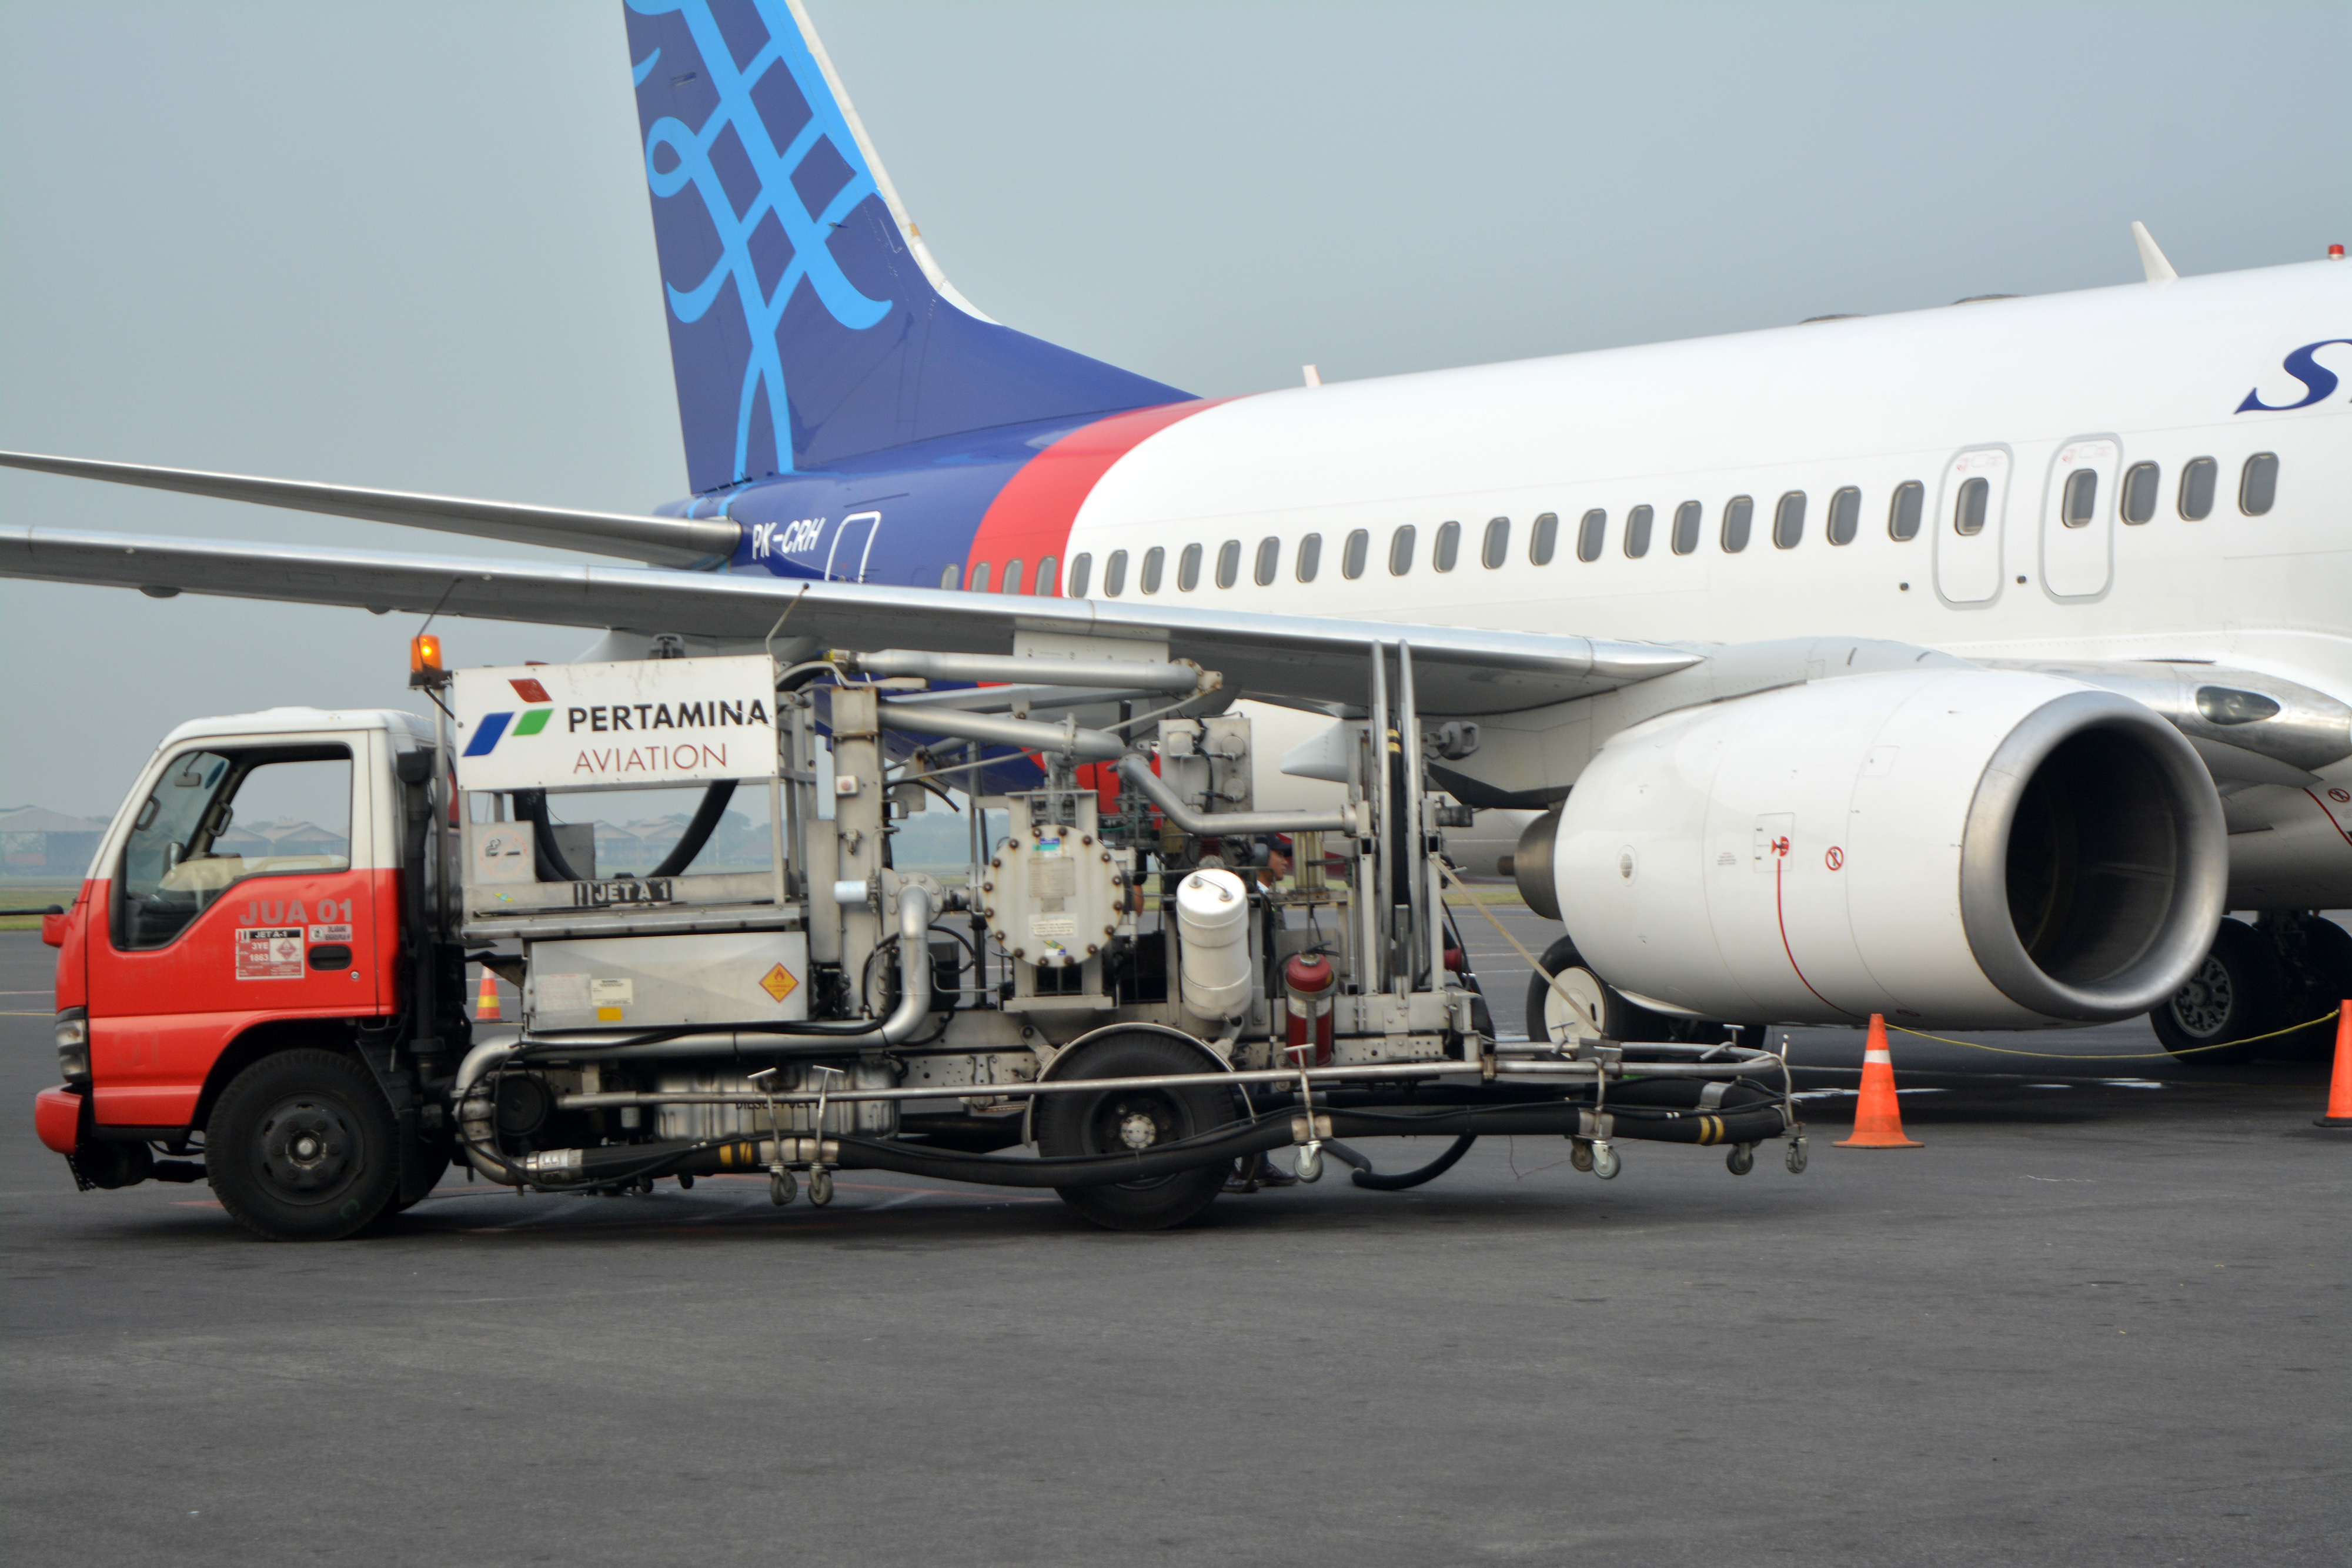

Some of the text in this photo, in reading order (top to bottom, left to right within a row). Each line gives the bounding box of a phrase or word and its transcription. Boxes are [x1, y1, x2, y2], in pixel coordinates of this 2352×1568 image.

[2233, 339, 2352, 414] S
[752, 517, 826, 560] PK-CRH
[568, 698, 769, 733] PERTAMINA
[573, 743, 726, 774] AVIATION
[595, 881, 668, 901] JET A 1
[239, 898, 352, 925] JUA 01
[249, 953, 269, 962] 1863
[251, 942, 269, 950] 3YE
